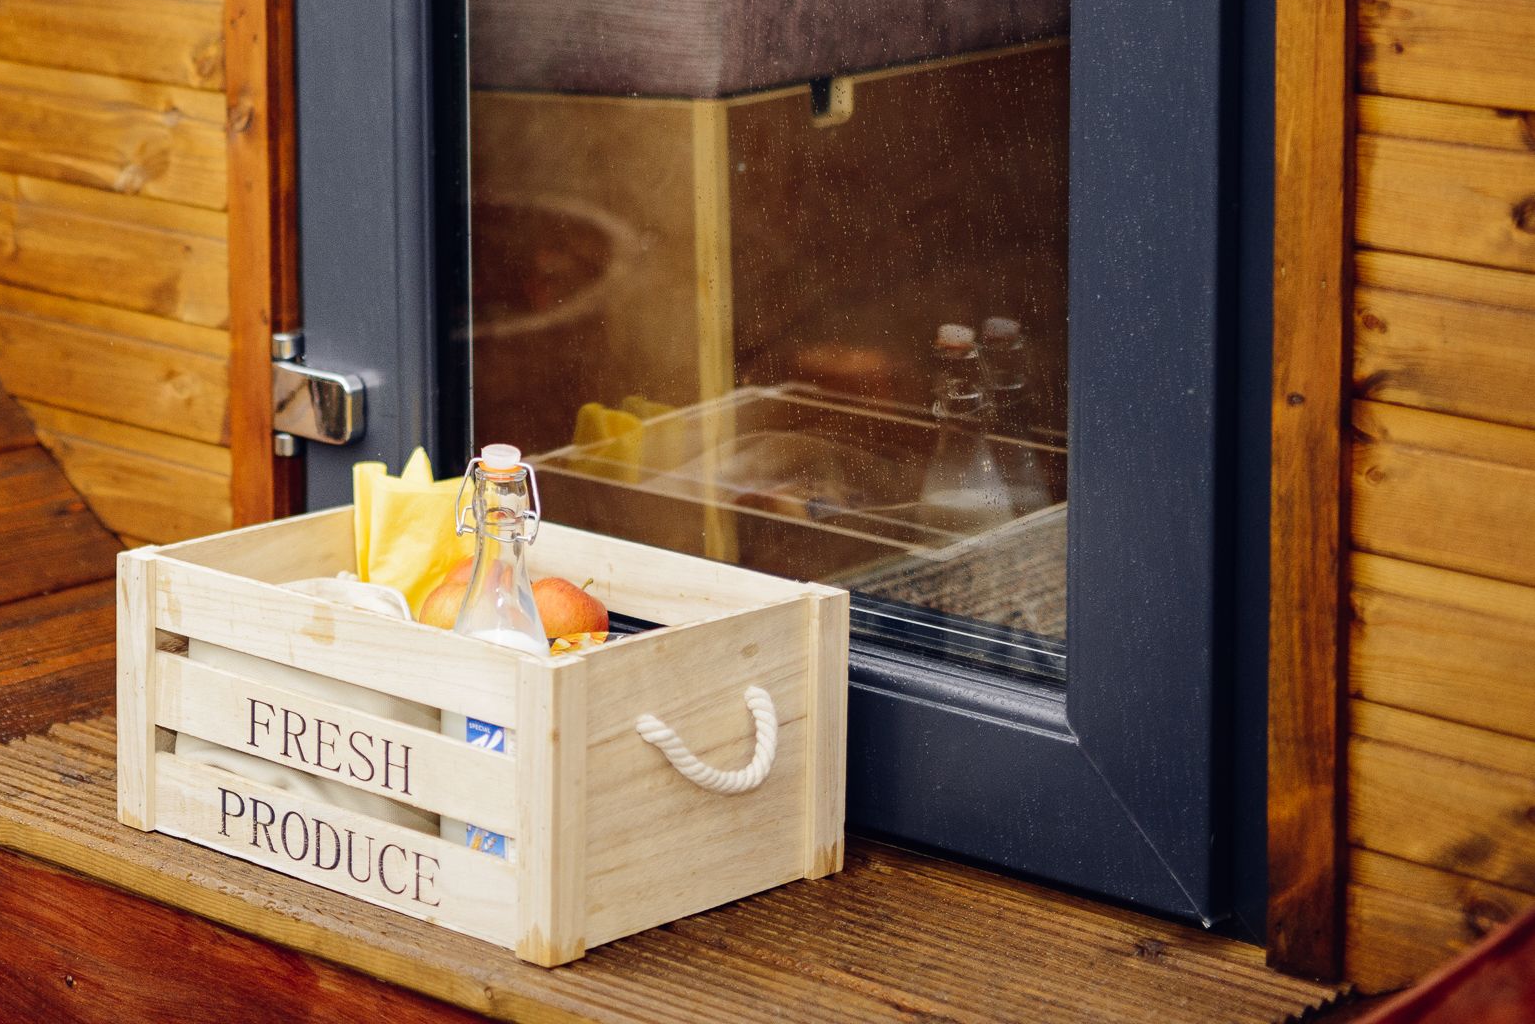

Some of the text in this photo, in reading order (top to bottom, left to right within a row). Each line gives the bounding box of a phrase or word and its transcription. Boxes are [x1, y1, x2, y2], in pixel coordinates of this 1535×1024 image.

[246, 697, 413, 796] FRESH
[469, 722, 491, 734] SPECIAL
[217, 786, 442, 907] PRODUCE
